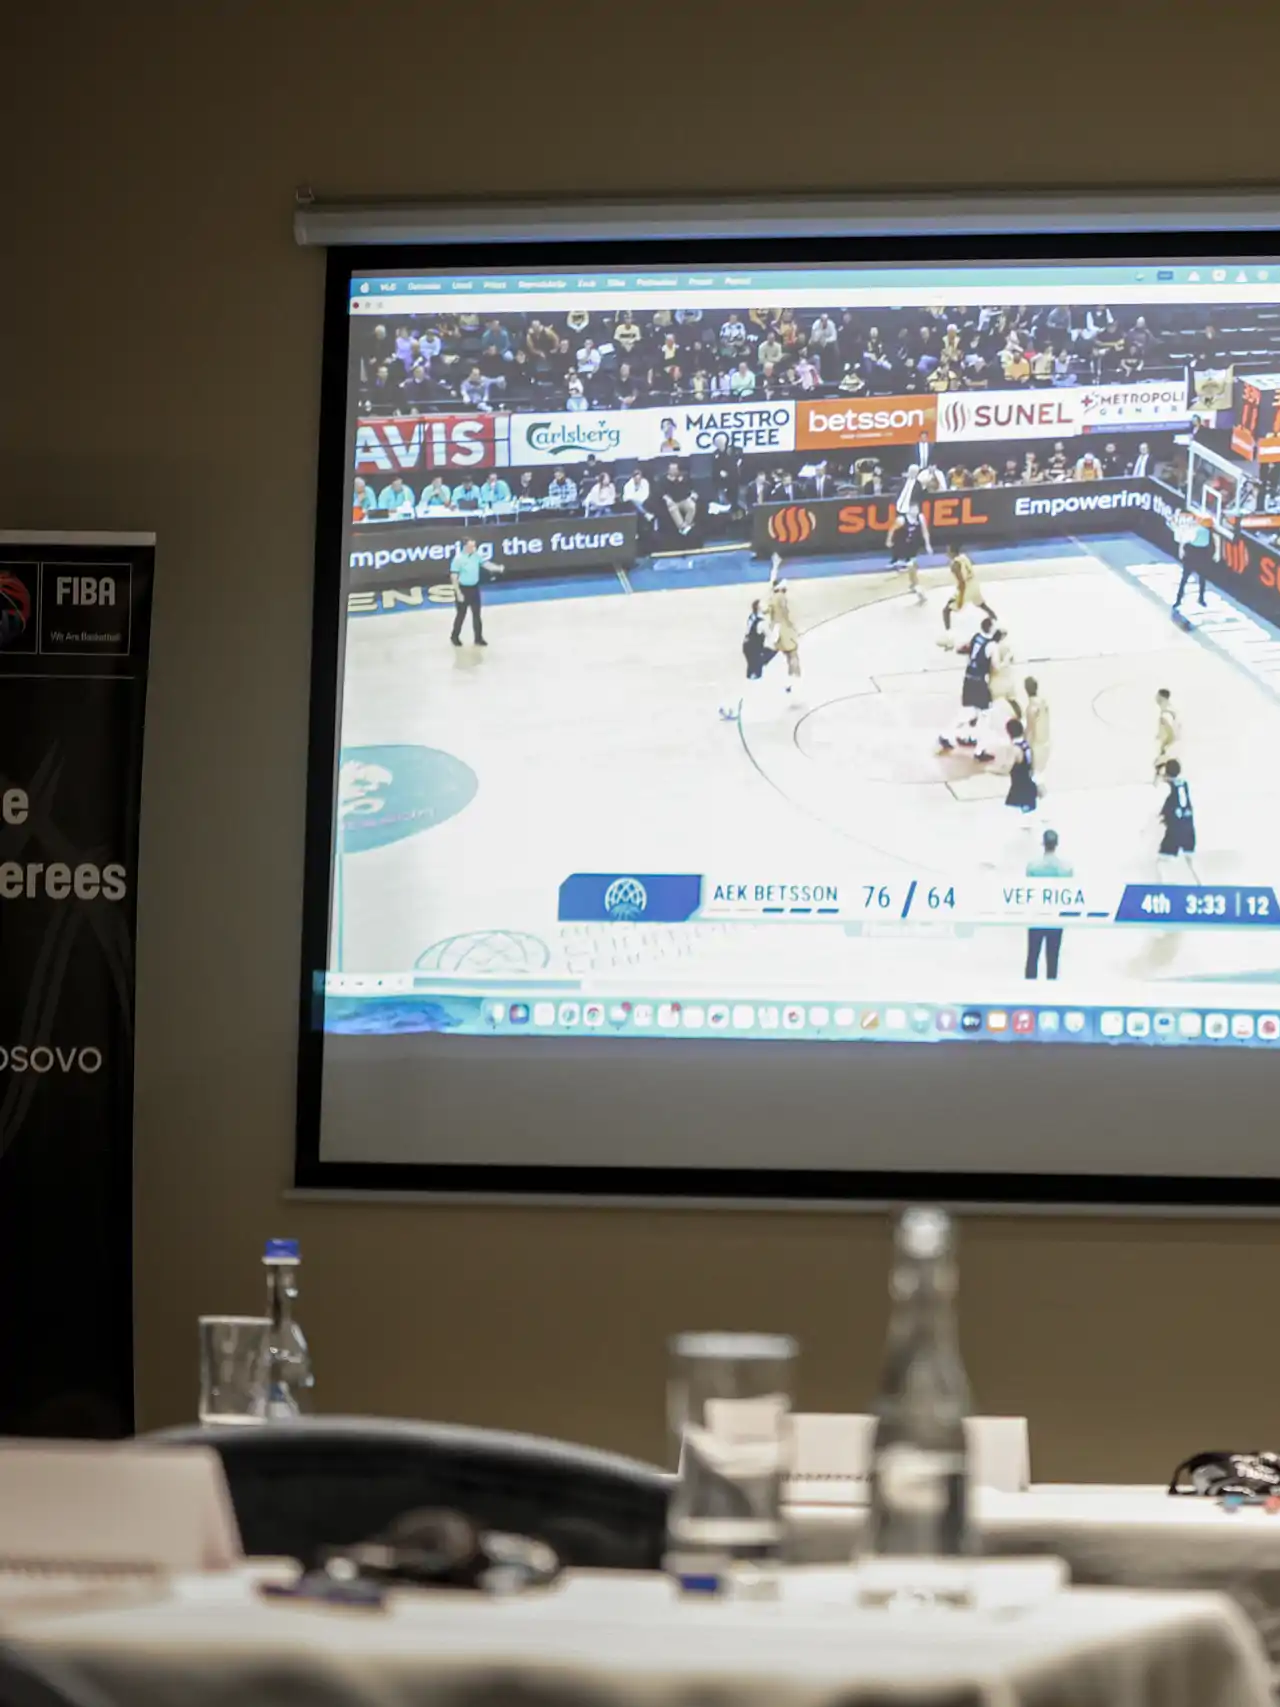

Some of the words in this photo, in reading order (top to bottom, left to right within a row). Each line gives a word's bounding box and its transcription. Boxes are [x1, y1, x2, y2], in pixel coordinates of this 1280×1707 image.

[686, 409, 790, 431] MAESTRO
[808, 409, 924, 433] betsson
[974, 402, 1074, 428] SUNEL
[355, 421, 485, 470] AVIS
[526, 420, 621, 452] Carlsberg
[696, 428, 780, 450] COFFEE
[1015, 490, 1151, 516] Empowering
[349, 541, 493, 569] mpowerig
[502, 537, 543, 555] the
[550, 530, 624, 551] future
[57, 576, 116, 606] FIBA
[714, 885, 748, 901] AEK
[755, 885, 838, 902] BETSSON
[862, 886, 891, 909] 76
[928, 886, 956, 909] 64
[1003, 888, 1034, 905] VEF
[1043, 888, 1085, 905] RIGA
[1141, 893, 1171, 915] 4th
[1185, 894, 1226, 916] 3:33
[1248, 896, 1269, 916] 12
